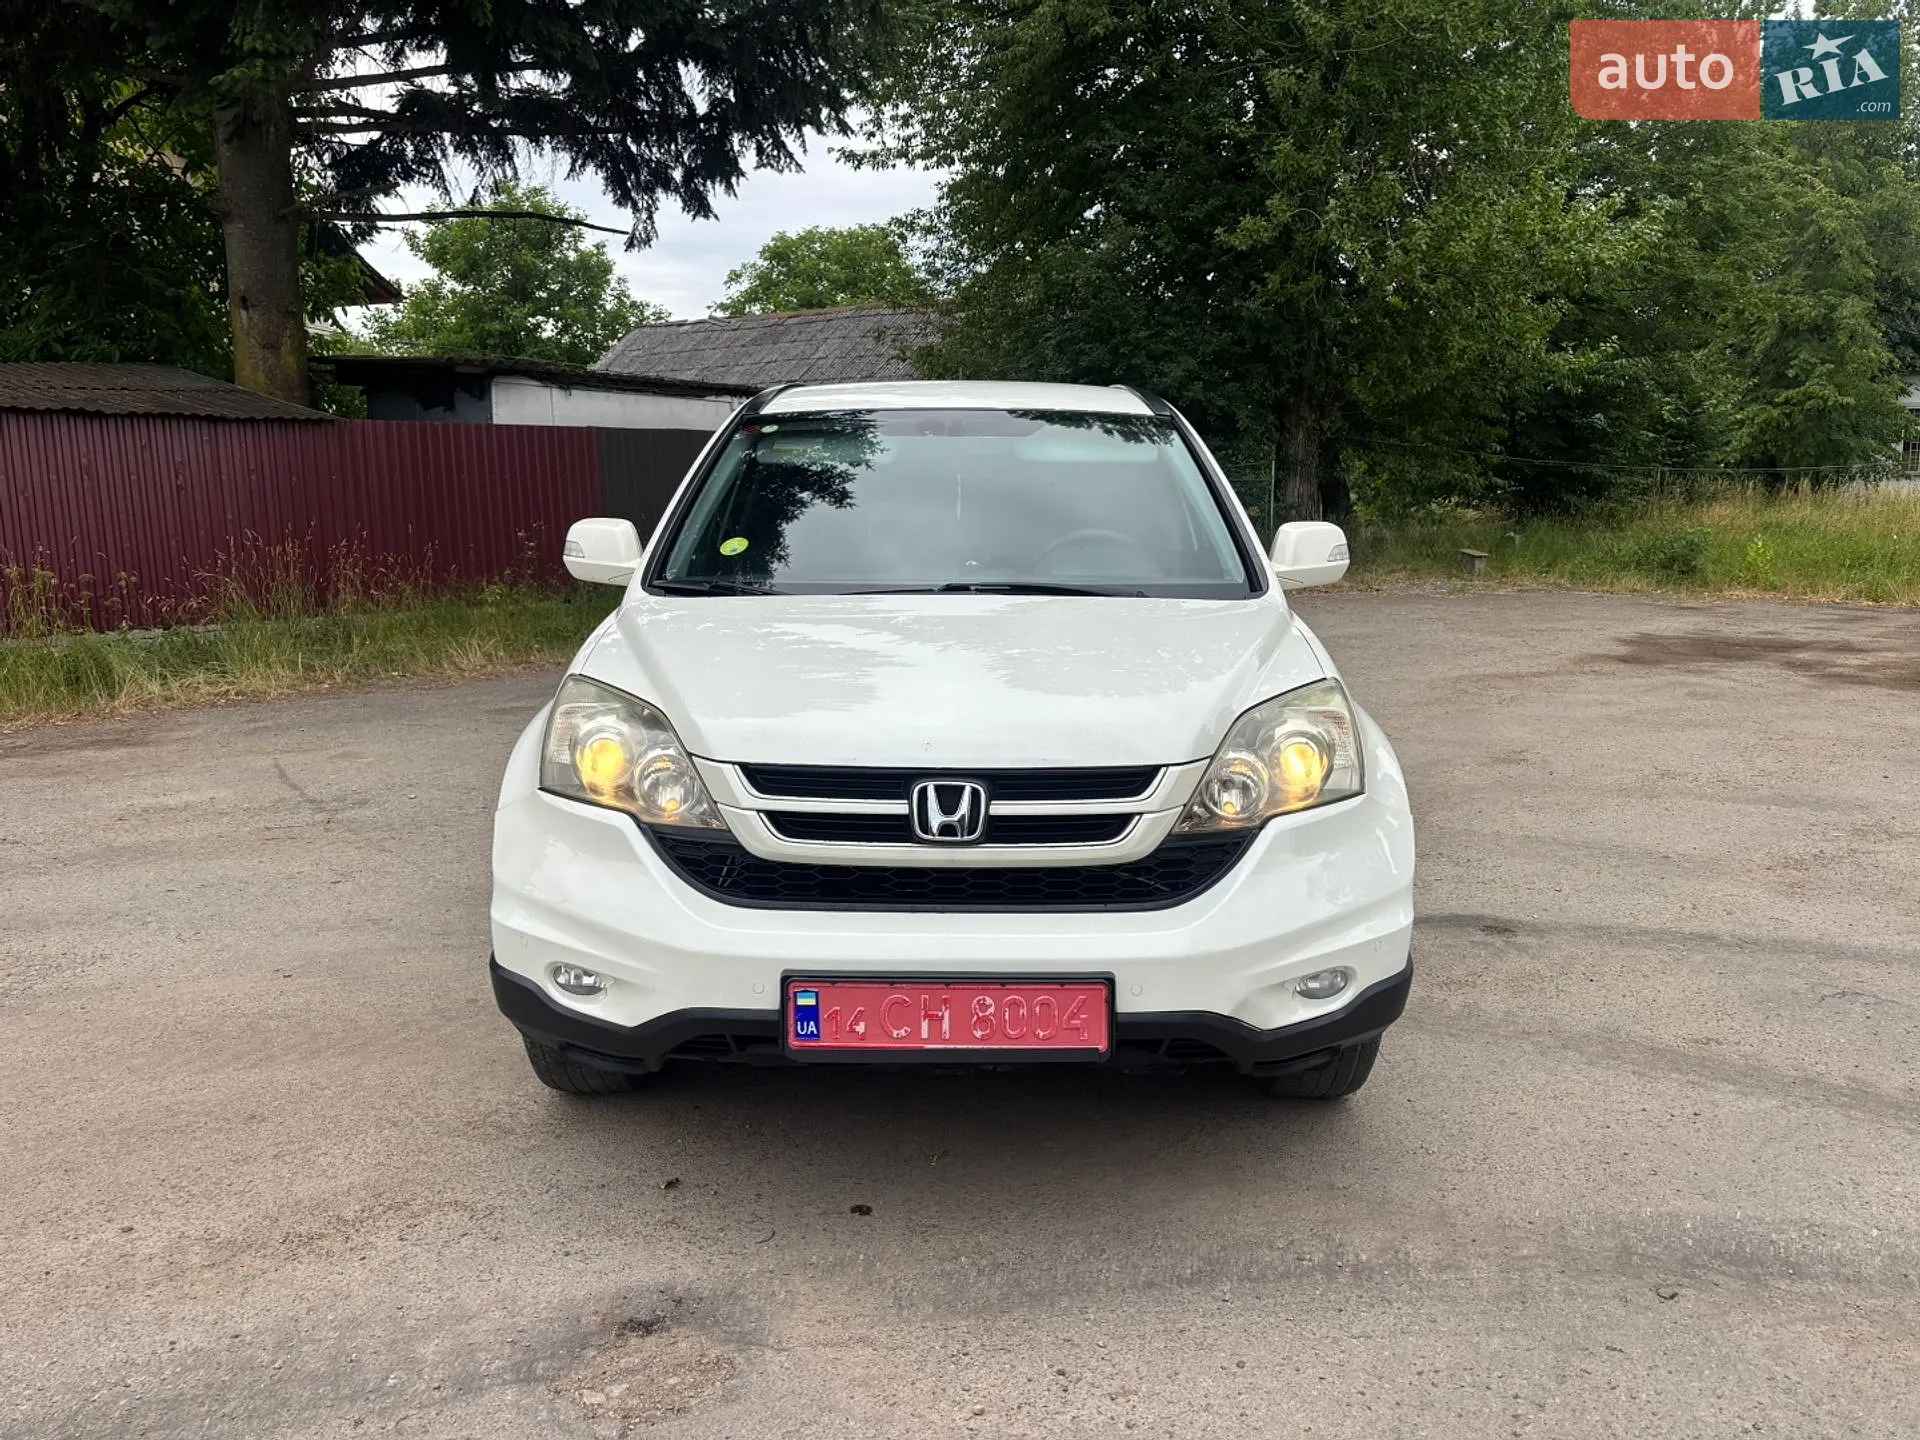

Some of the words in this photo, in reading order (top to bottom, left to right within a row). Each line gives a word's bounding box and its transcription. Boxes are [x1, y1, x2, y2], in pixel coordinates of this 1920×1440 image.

[796, 1020, 818, 1036] UA
[823, 1006, 866, 1041] 14
[880, 994, 950, 1040] CH
[971, 994, 1090, 1041] 8004
